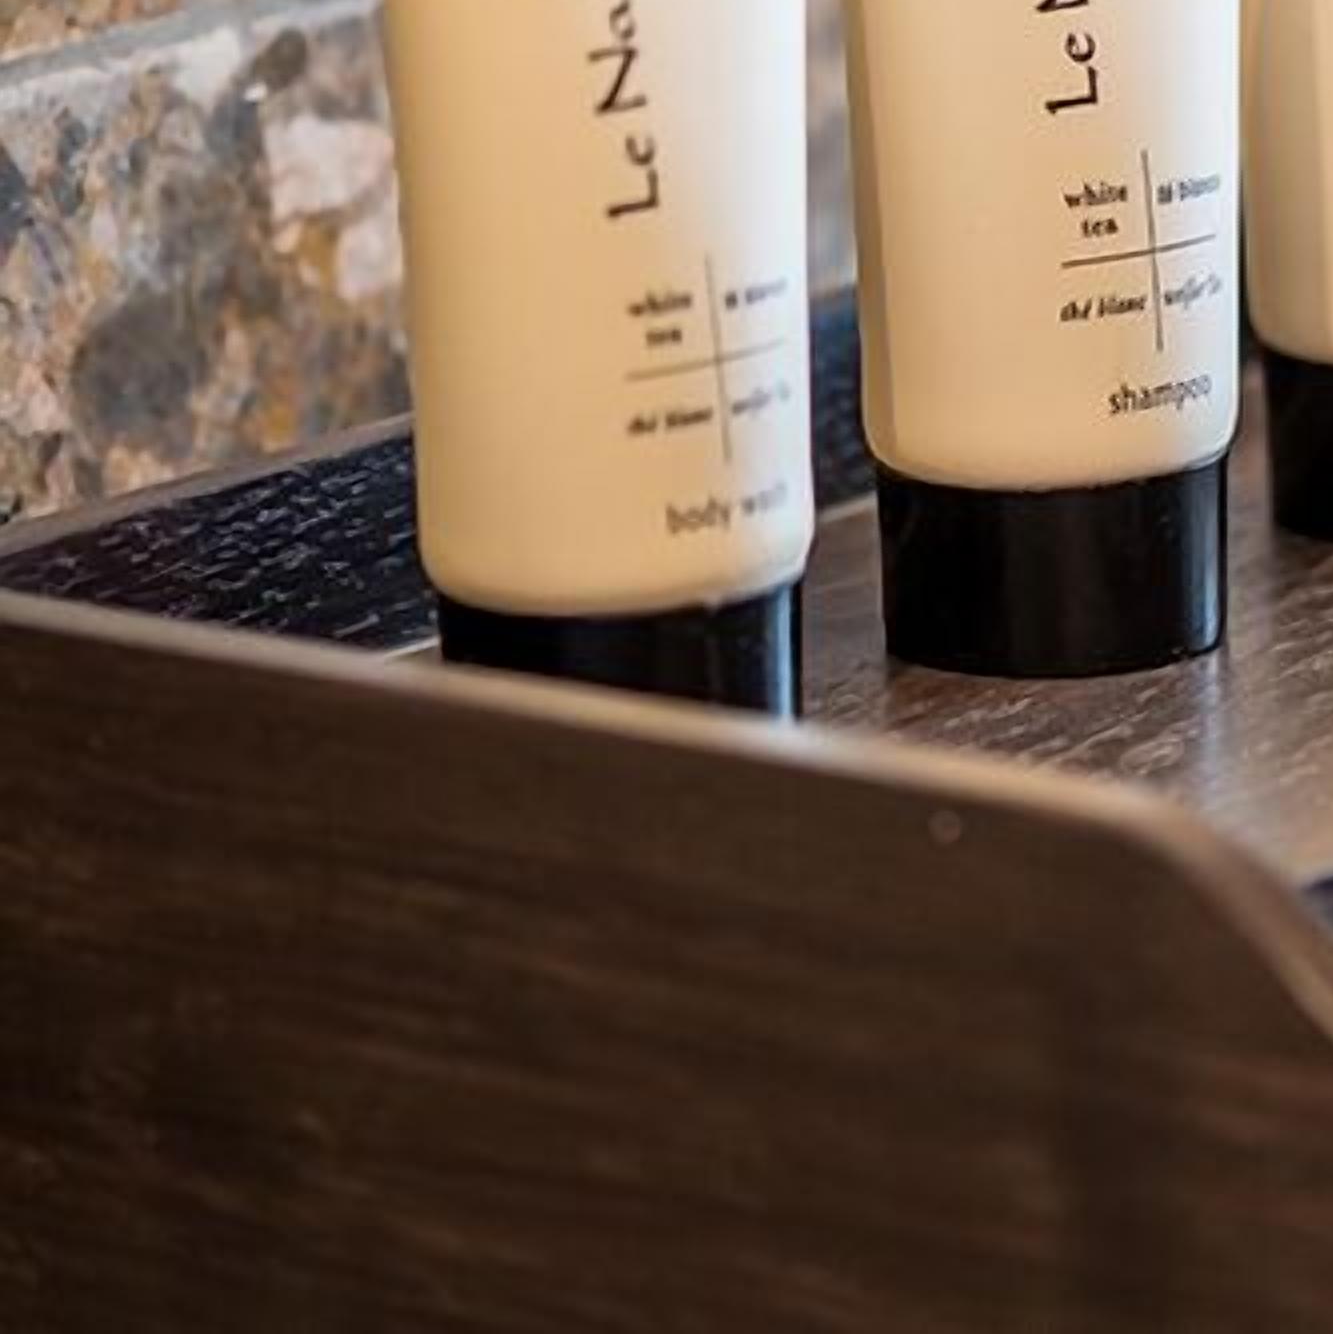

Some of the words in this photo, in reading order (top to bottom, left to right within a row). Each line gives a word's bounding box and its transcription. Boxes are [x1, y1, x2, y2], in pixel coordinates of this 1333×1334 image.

[1045, 33, 1099, 115] Le
[606, 134, 660, 220] Le
[1108, 374, 1213, 415] shampoo
